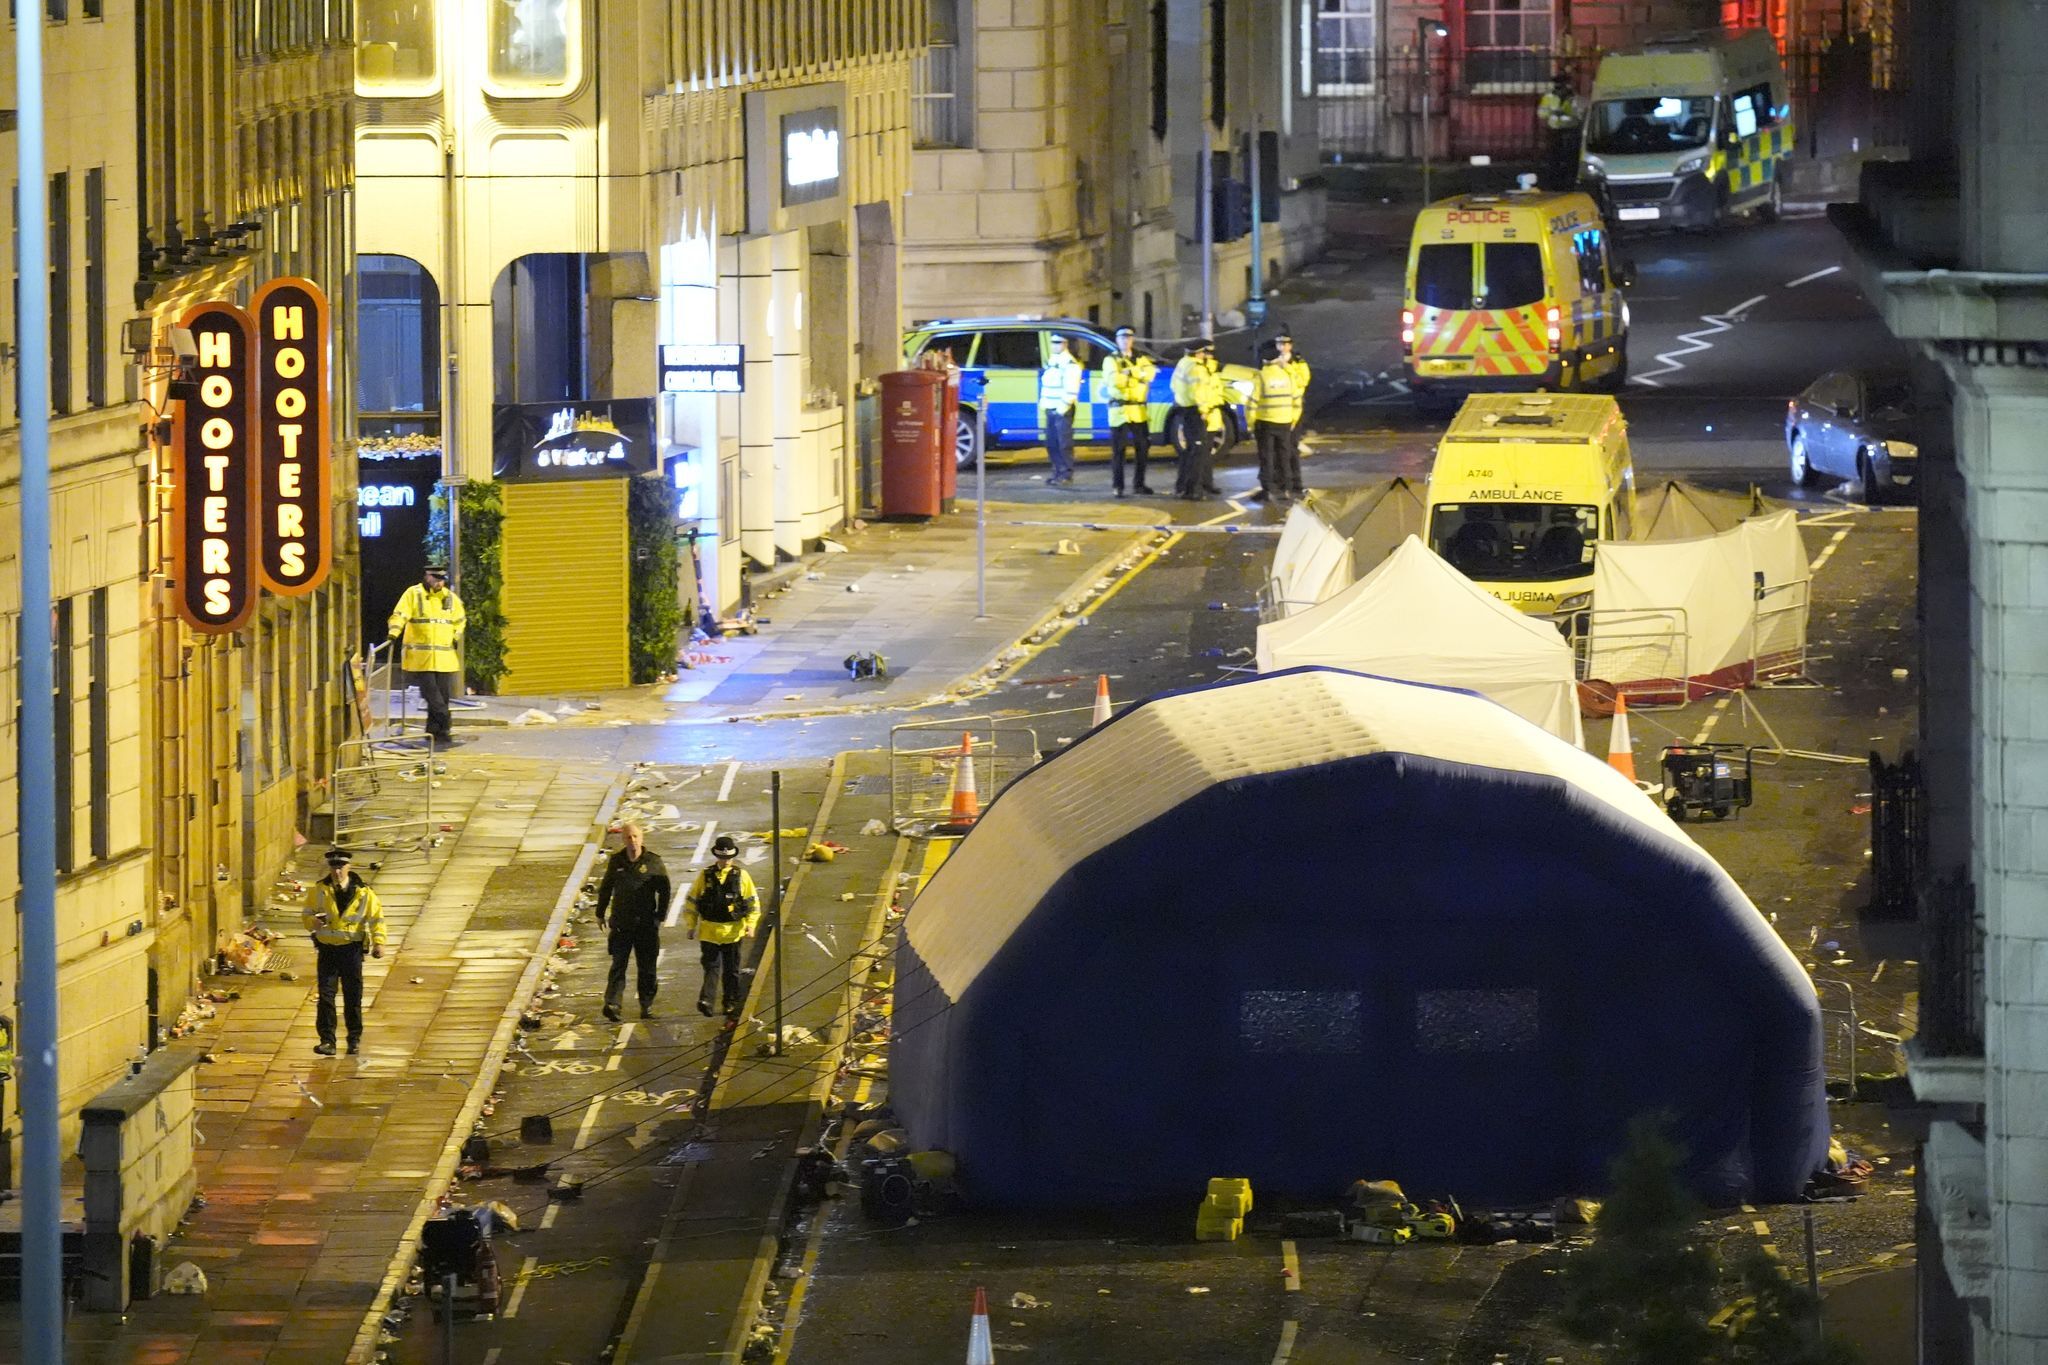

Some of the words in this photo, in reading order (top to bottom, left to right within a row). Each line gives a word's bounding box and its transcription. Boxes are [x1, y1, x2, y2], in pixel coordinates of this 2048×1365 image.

[1447, 210, 1511, 224] POLICE
[272, 305, 307, 578] HOOTERS
[199, 331, 234, 616] HOOTERS
[1467, 469, 1494, 477] A740
[1469, 489, 1563, 501] AMBULANCE
